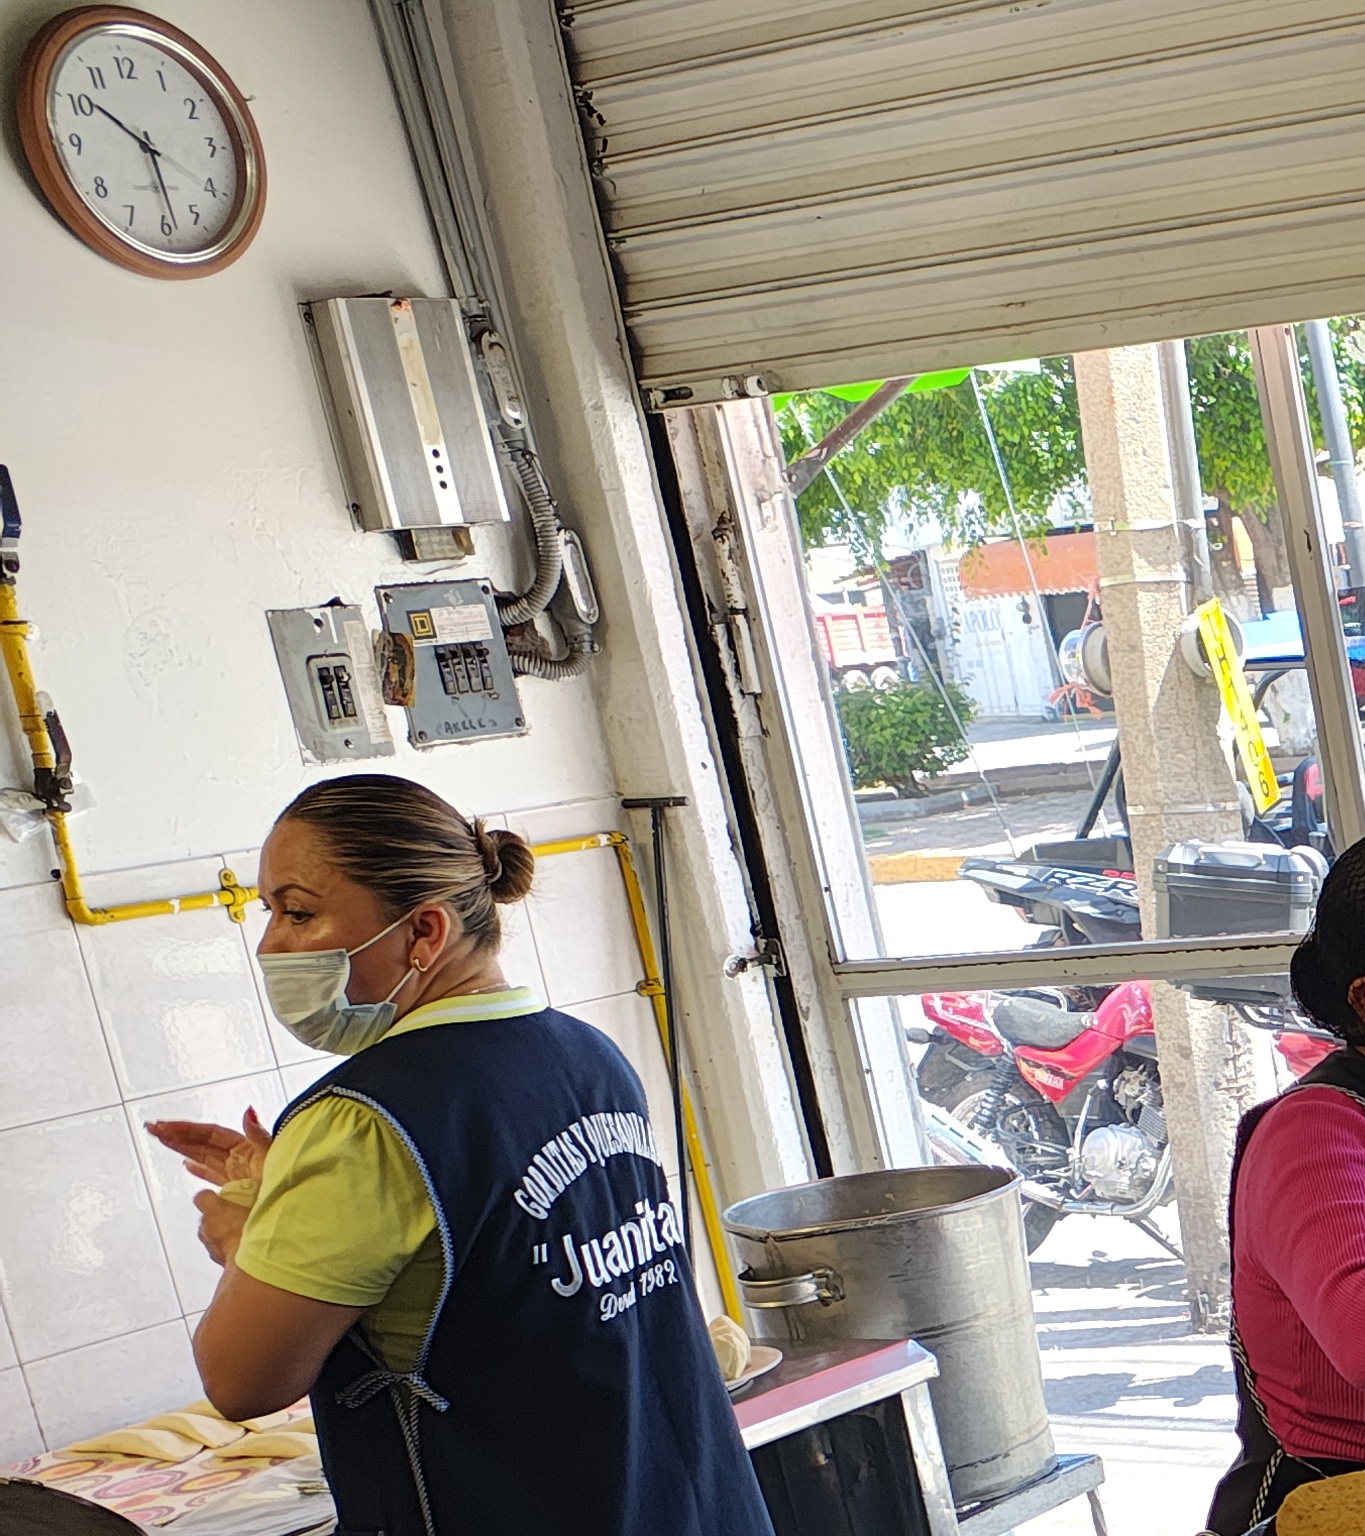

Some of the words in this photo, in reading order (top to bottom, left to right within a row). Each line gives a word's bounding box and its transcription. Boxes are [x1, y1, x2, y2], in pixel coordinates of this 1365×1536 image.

[86, 66, 106, 90] 11
[112, 55, 139, 80] 12
[155, 70, 167, 92] 1
[66, 93, 95, 117] 10
[183, 97, 200, 120] 2
[68, 132, 82, 156] 9
[203, 136, 217, 158] 3
[93, 175, 108, 199] 8
[203, 177, 217, 199] 4
[121, 204, 135, 227] 7
[160, 214, 172, 237] 6
[187, 204, 200, 226] 5
[568, 1121, 598, 1164] Y
[581, 1111, 662, 1168] QUESADILLA
[513, 1130, 588, 1220] GORDITAS
